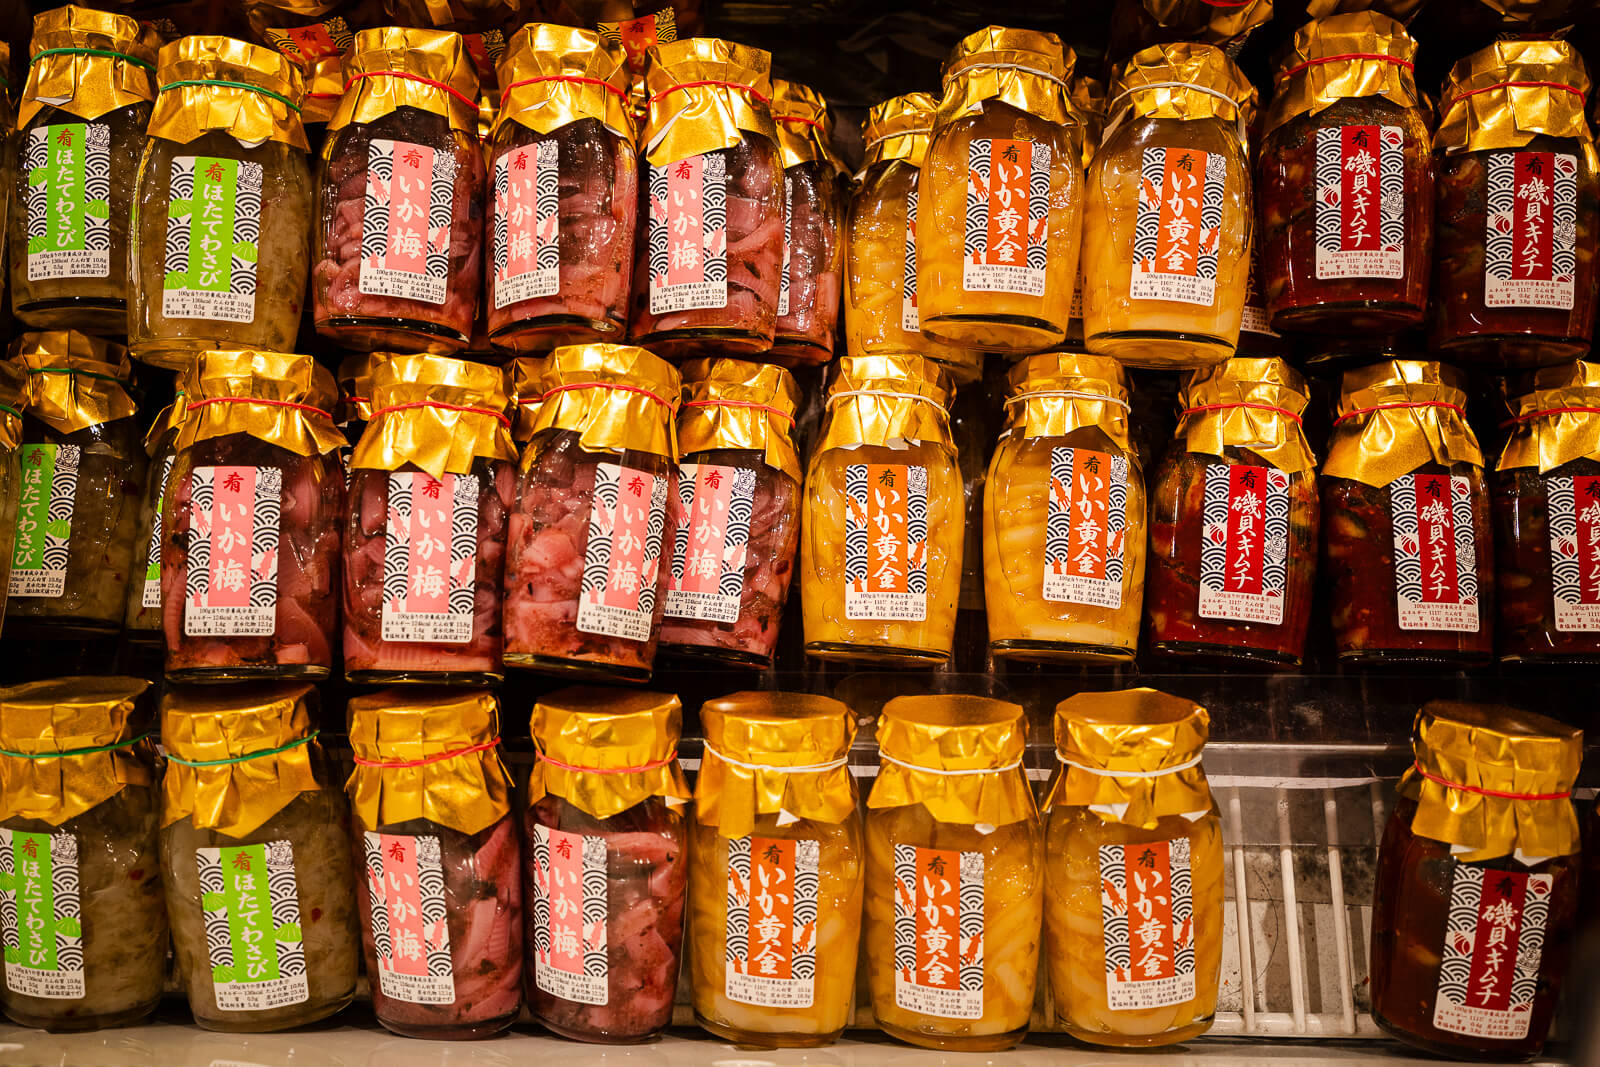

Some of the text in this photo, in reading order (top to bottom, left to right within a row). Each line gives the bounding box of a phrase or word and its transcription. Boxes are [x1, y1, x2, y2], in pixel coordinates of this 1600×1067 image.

[56, 128, 76, 148] 肴
[1351, 129, 1371, 148] 肴
[401, 149, 424, 169] 肴
[513, 151, 529, 171] 肴
[1001, 144, 1021, 164] 肴
[1175, 153, 1196, 173] 肴
[203, 162, 226, 183] 肴
[674, 163, 694, 181] 肴
[55, 149, 77, 248] ほたてわさび
[390, 175, 426, 260] いか梅
[509, 178, 535, 265] いか梅
[991, 162, 1026, 263] いか黄金
[1160, 171, 1199, 271] いか黄金
[198, 183, 224, 287] ほたてわさび
[670, 188, 701, 271] いか梅
[1082, 455, 1102, 475] 肴
[222, 471, 245, 494] 肴
[421, 478, 444, 500] 肴
[627, 475, 646, 498] 肴
[703, 468, 724, 491] 肴
[878, 468, 897, 488] 肴
[1239, 470, 1259, 489] 肴
[1423, 478, 1443, 499] 肴
[15, 469, 41, 566] ほたてわさび
[1071, 472, 1106, 574] いか黄金
[211, 502, 248, 593] いか梅
[609, 503, 645, 595] いか梅
[689, 497, 725, 580] いか梅
[871, 487, 904, 590] いか黄金
[410, 508, 447, 599] いか梅
[20, 837, 40, 859] 肴
[387, 840, 406, 863] 肴
[555, 837, 573, 860] 肴
[762, 843, 784, 866] 肴
[1136, 847, 1158, 869] 肴
[231, 850, 254, 872] 肴
[927, 855, 948, 877] 肴
[22, 859, 49, 965] ほたてわさび
[388, 871, 423, 962] いか梅
[552, 866, 580, 959] いか梅
[752, 863, 790, 975] いか黄金
[1132, 870, 1169, 977] いか黄金
[234, 873, 269, 979] ほたてわさび
[920, 875, 956, 985] いか黄金
